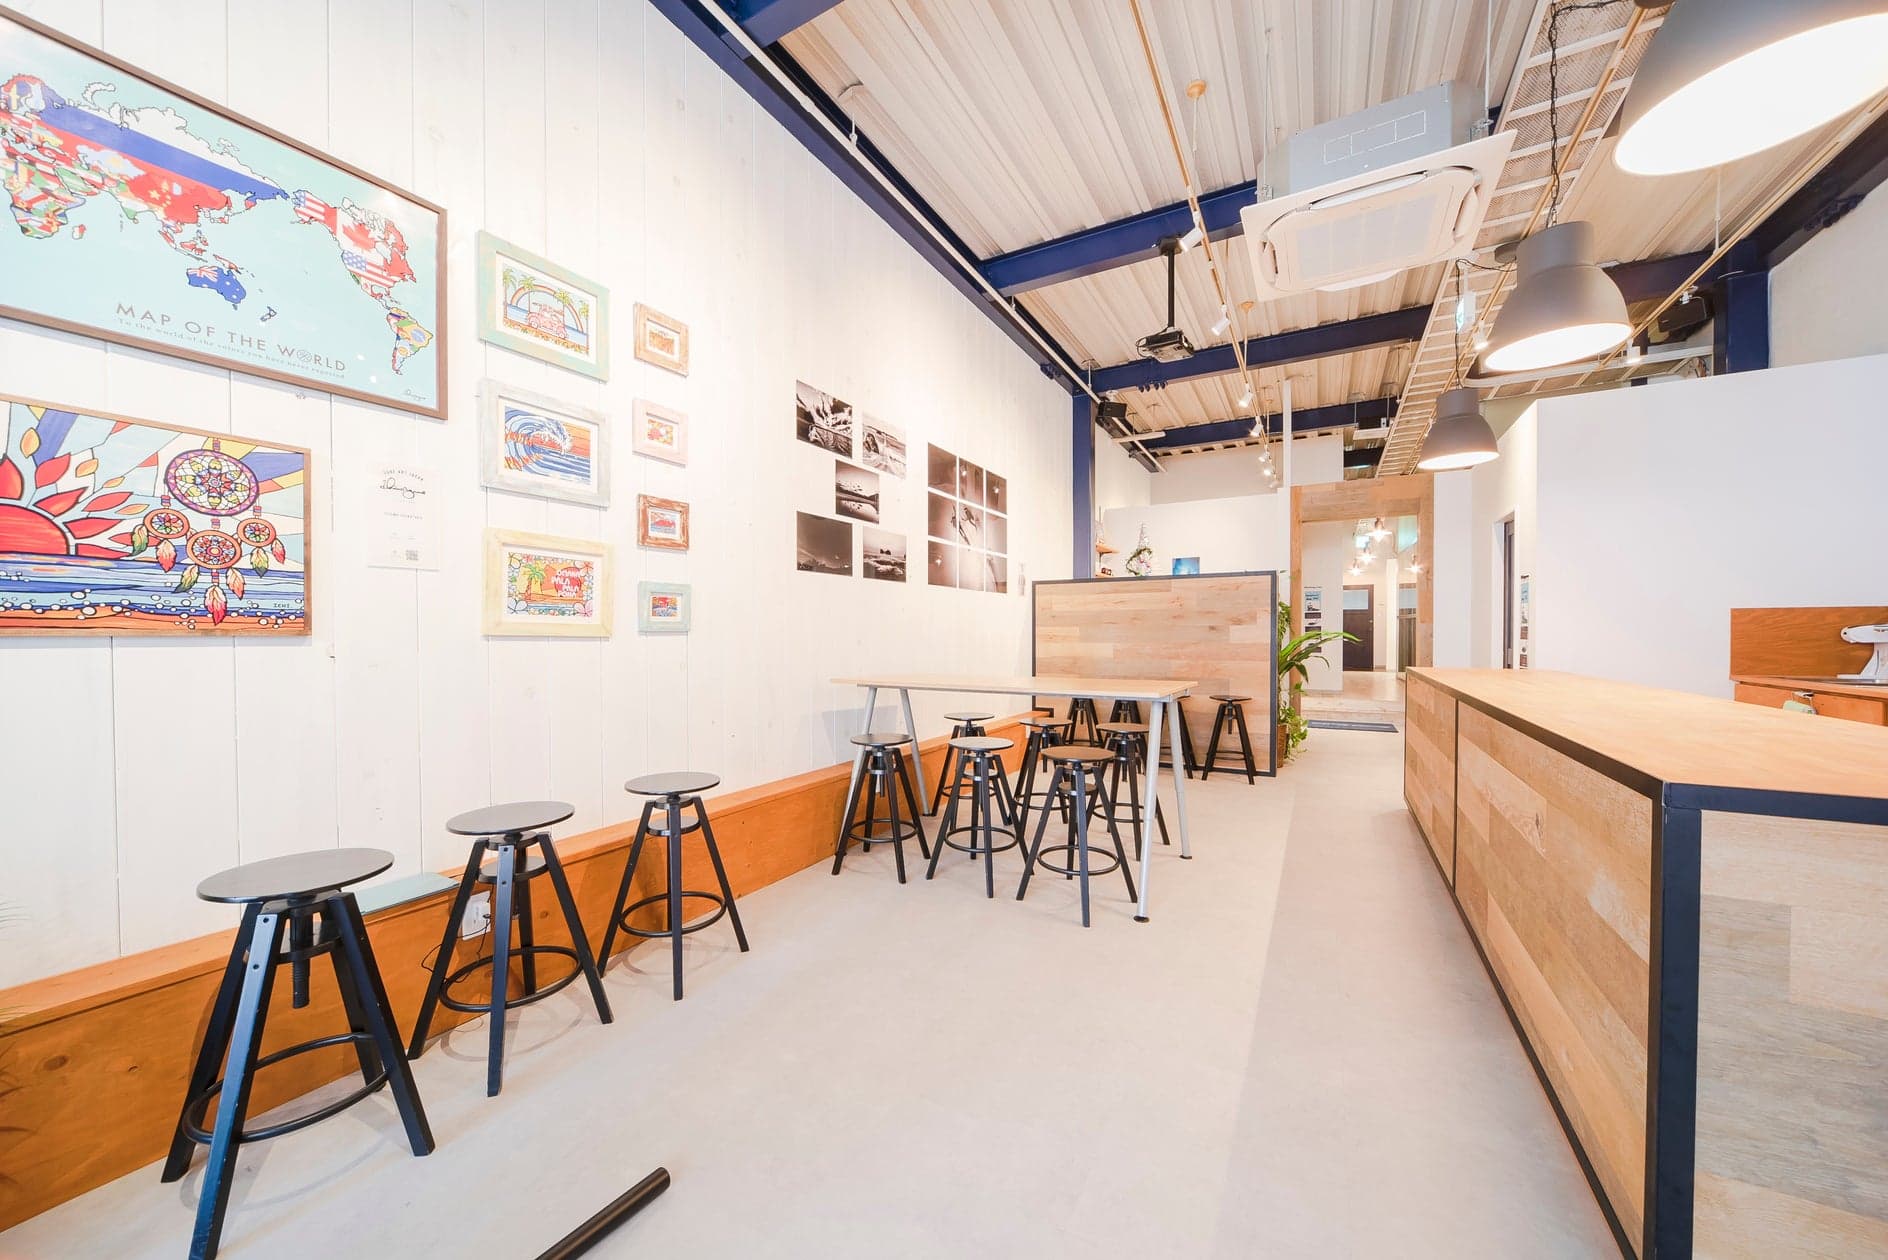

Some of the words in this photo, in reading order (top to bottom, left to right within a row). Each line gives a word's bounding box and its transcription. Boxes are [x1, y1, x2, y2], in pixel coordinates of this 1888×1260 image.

[116, 302, 170, 326] MAP
[184, 321, 216, 337] OF
[227, 330, 267, 352] THE
[277, 344, 346, 372] WORLD
